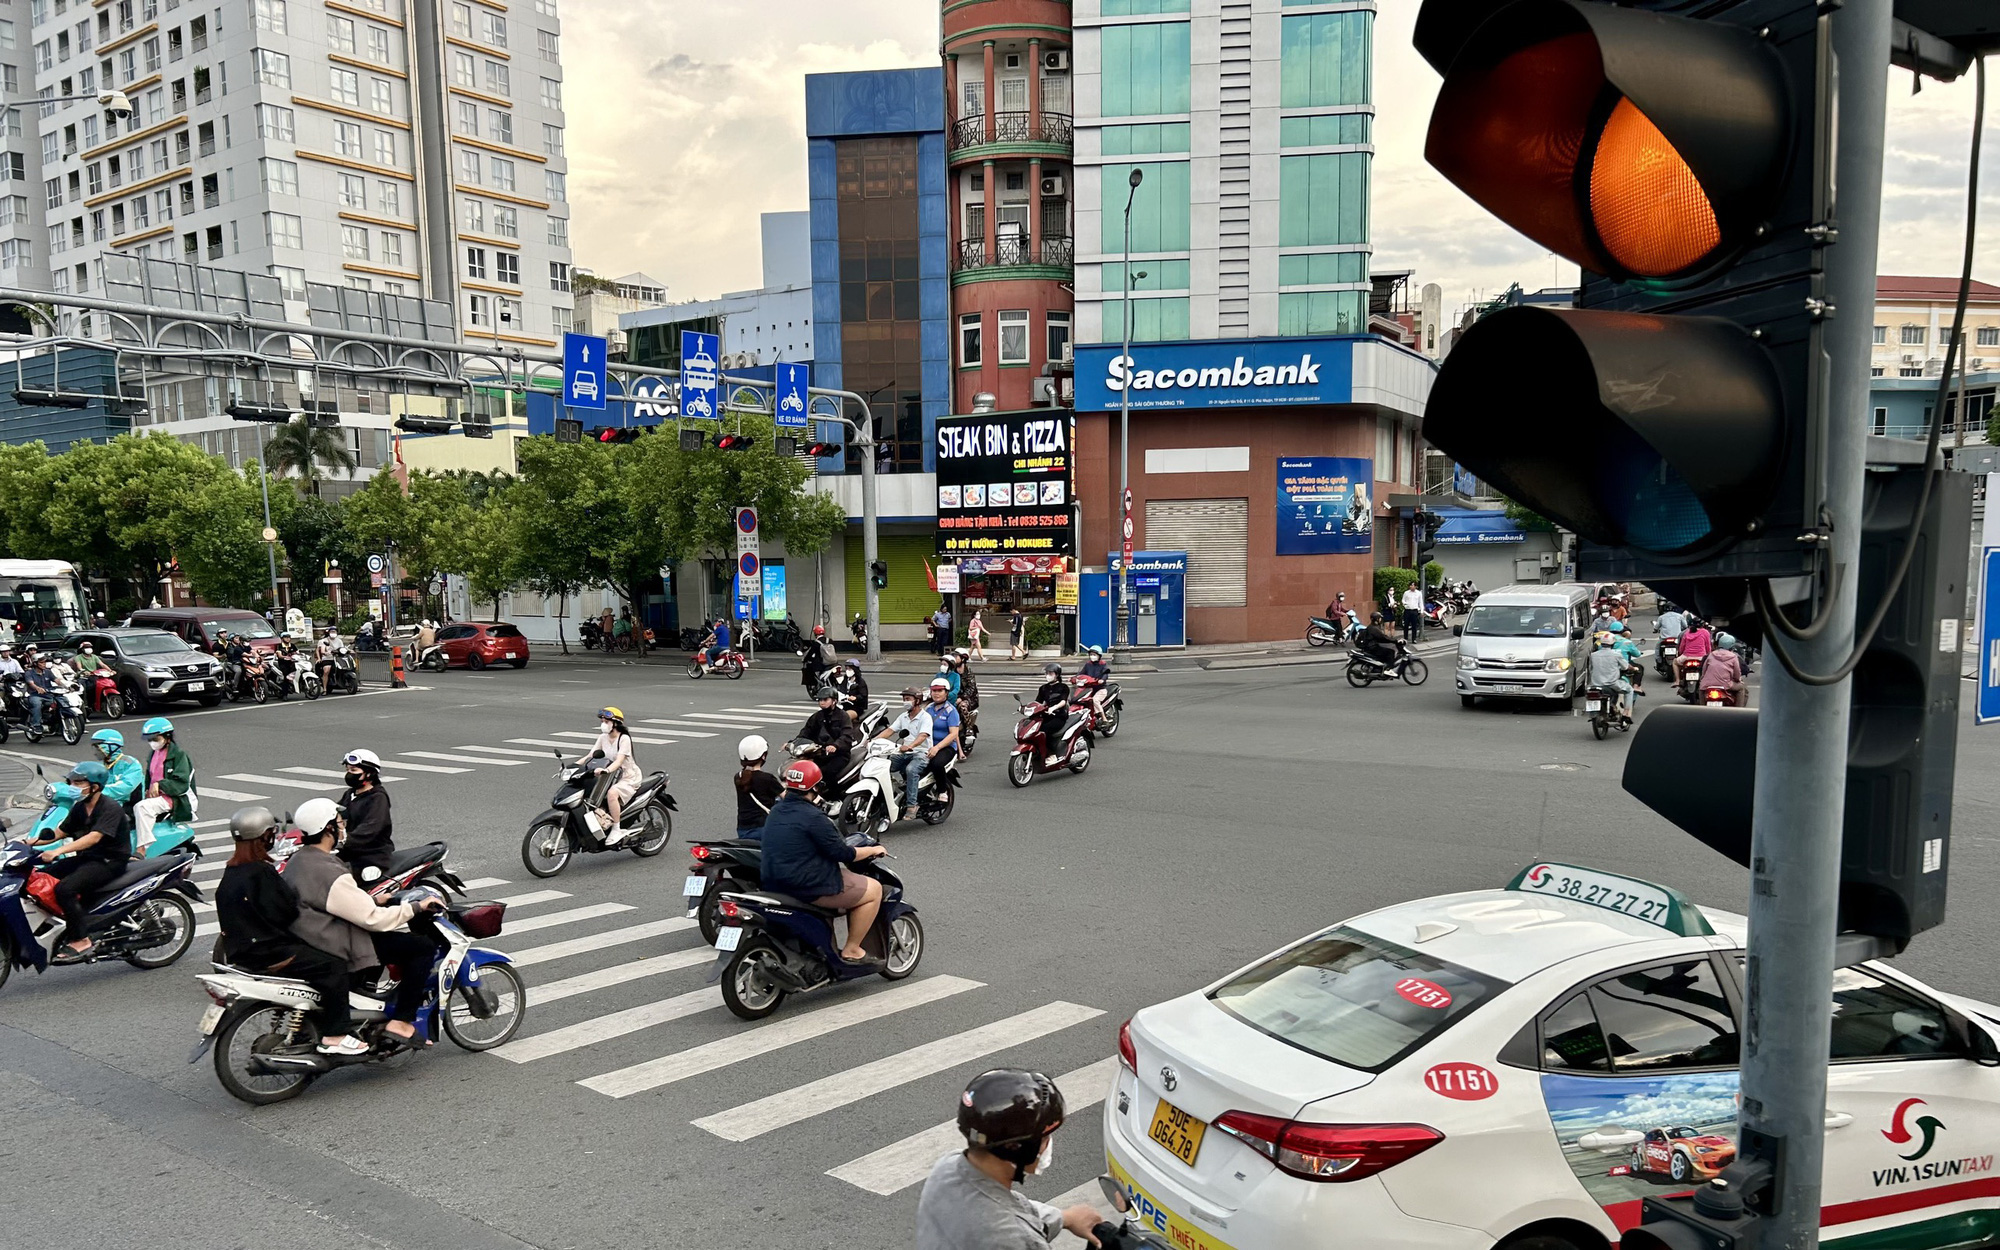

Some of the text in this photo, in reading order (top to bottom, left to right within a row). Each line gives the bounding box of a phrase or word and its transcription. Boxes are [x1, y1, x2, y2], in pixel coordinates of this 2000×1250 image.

[1106, 354, 1321, 390] Sacombank
[792, 415, 806, 424] BÁNH
[938, 420, 1065, 458] STEAK BIN & PIZZA
[1014, 456, 1064, 468] CHI NHÁNH 22
[939, 518, 954, 527] GIAO
[956, 515, 974, 527] HÀNG
[975, 516, 988, 529] TẬN
[989, 515, 1003, 526] NHÀ
[1007, 517, 1019, 526] Tel
[1020, 516, 1038, 526] 0838
[1040, 515, 1053, 526] 525
[946, 538, 956, 549] BÒ
[958, 538, 970, 549] MỸ
[972, 537, 998, 549] NƯỚNG
[1004, 537, 1015, 548] BÒ
[1017, 538, 1053, 548] HOKUBEE
[1111, 559, 1184, 571] Scombank
[1610, 892, 1639, 912] 27
[1639, 899, 1667, 922] 27
[1399, 978, 1450, 1008] 17151
[1428, 1068, 1491, 1092] 17151
[1169, 1105, 1192, 1133] 50E
[1154, 1120, 1193, 1160] 064.78
